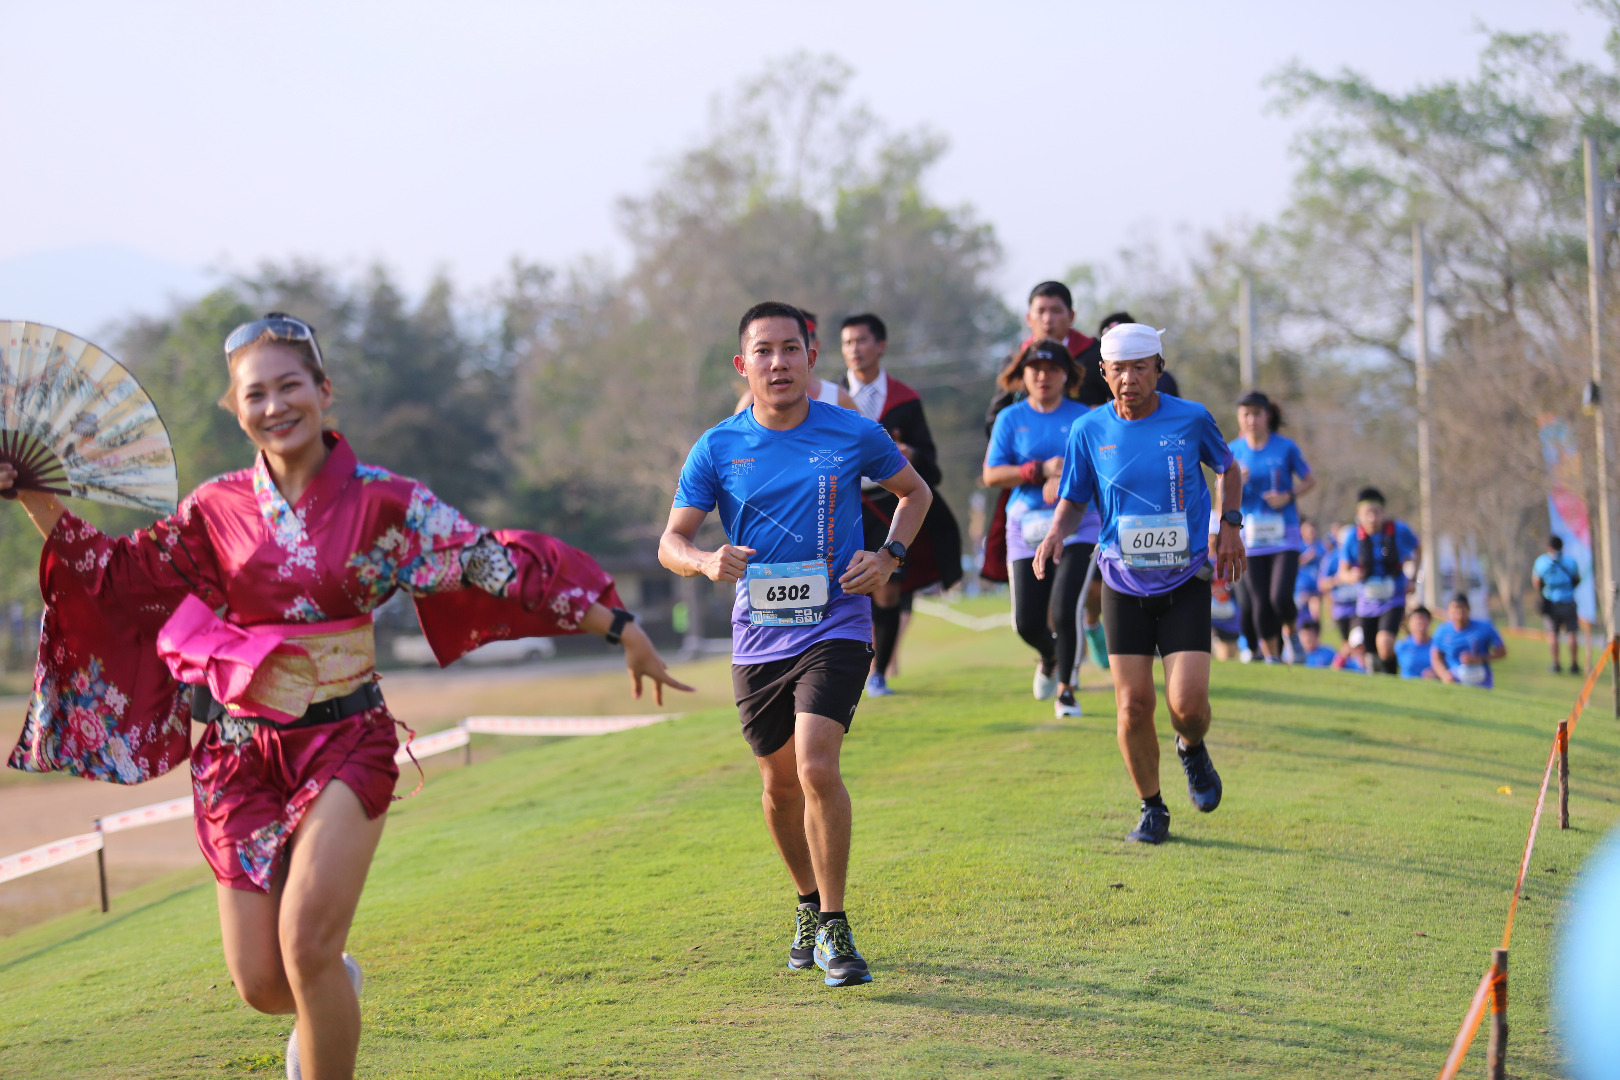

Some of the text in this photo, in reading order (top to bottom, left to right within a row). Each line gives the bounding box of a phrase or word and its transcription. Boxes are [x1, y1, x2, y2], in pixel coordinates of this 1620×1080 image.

[1167, 455, 1176, 480] CROSS
[1176, 455, 1184, 487] SINGHA
[818, 475, 826, 506] CROSS
[828, 474, 837, 514] SINGHA
[817, 507, 825, 551] COUNTRY
[827, 516, 835, 543] PARK
[1132, 530, 1177, 548] 6043
[766, 583, 810, 602] 6302
[813, 611, 823, 622] 16
